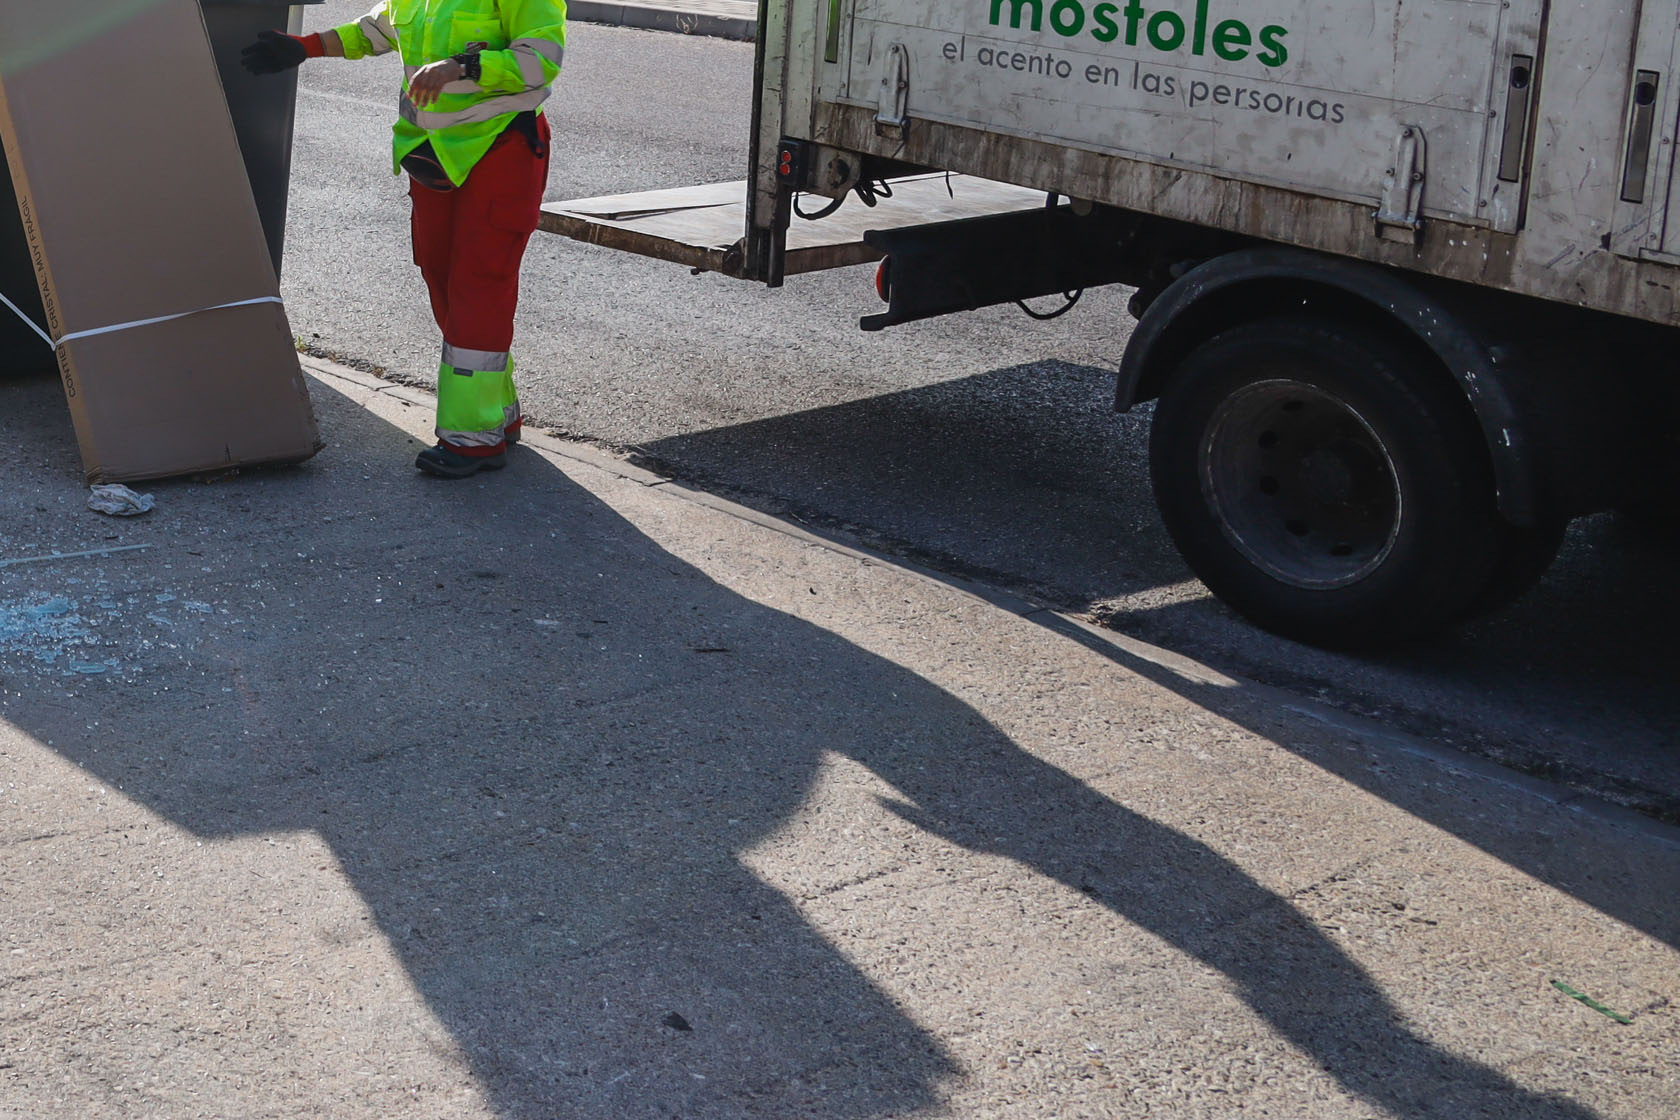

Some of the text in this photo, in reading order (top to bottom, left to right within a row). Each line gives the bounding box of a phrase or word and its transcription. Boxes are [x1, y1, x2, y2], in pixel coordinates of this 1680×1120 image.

[942, 36, 1346, 125] el acento en las personas
[31, 244, 45, 272] MUY
